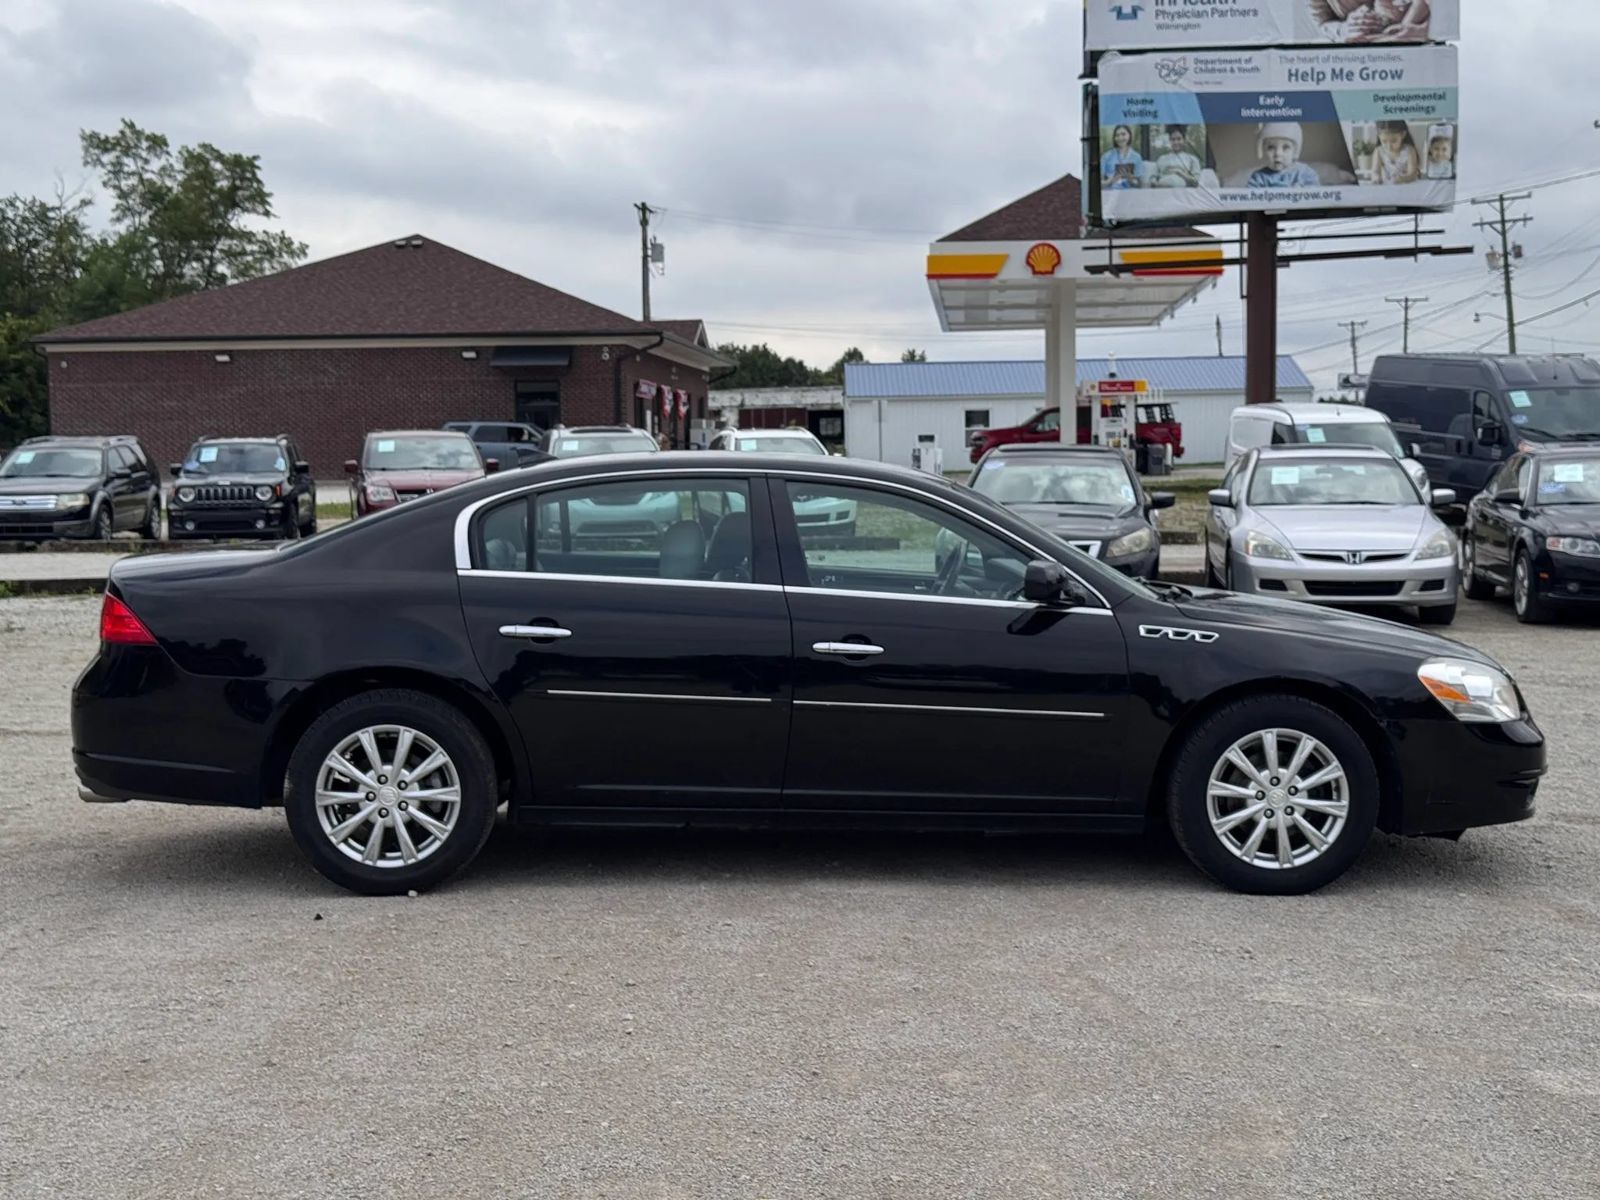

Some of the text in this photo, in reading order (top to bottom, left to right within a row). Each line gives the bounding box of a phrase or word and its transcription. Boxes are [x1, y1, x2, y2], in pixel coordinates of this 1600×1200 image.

[1155, 7, 1259, 21] Physician Partners
[1155, 23, 1201, 31] Wilmington
[1193, 57, 1252, 67] Department of
[1279, 56, 1295, 65] The
[1297, 55, 1319, 64] heart
[1321, 54, 1331, 64] of
[1332, 54, 1366, 65] thriving
[1193, 65, 1260, 74] Children & Youth
[1287, 66, 1404, 86] Help Me Grow
[1258, 94, 1285, 107] Early
[1373, 92, 1446, 103] Developmental
[1122, 108, 1158, 119] Visiting
[1241, 106, 1303, 118] Intervention
[1383, 103, 1436, 115] Screenings
[1219, 190, 1342, 203] www.helpmegrow.org
